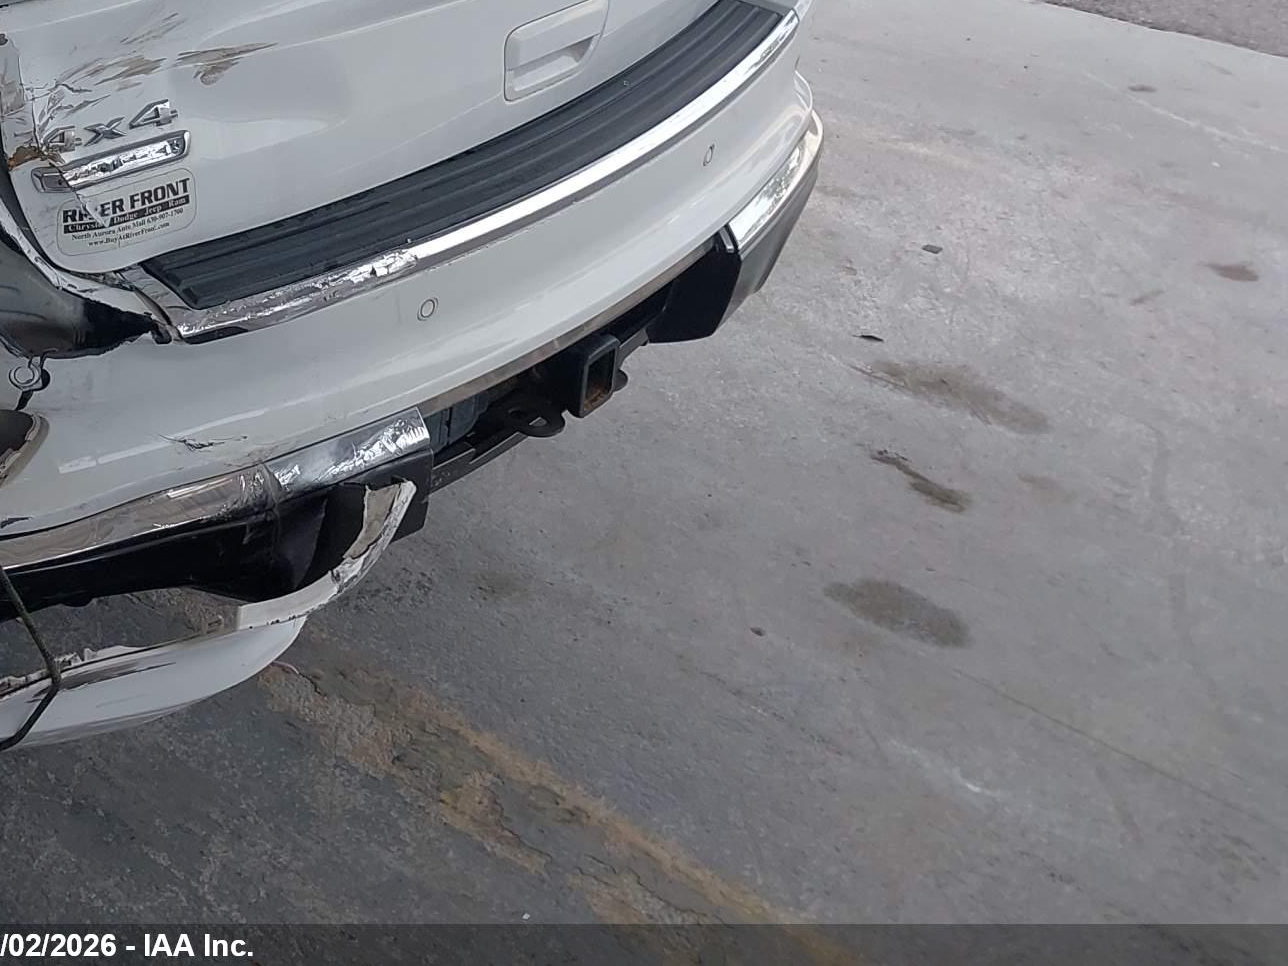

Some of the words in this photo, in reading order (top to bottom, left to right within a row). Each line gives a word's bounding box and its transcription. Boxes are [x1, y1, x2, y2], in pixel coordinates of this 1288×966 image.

[129, 177, 190, 209] FRONT
[68, 218, 105, 232] Chrysl
[114, 211, 138, 224] Dodge
[144, 204, 162, 216] Jeep
[168, 197, 186, 208] Ram
[71, 232, 92, 240] North
[92, 228, 116, 238] Aurora
[116, 223, 132, 233] Auto
[132, 218, 146, 228] Mall
